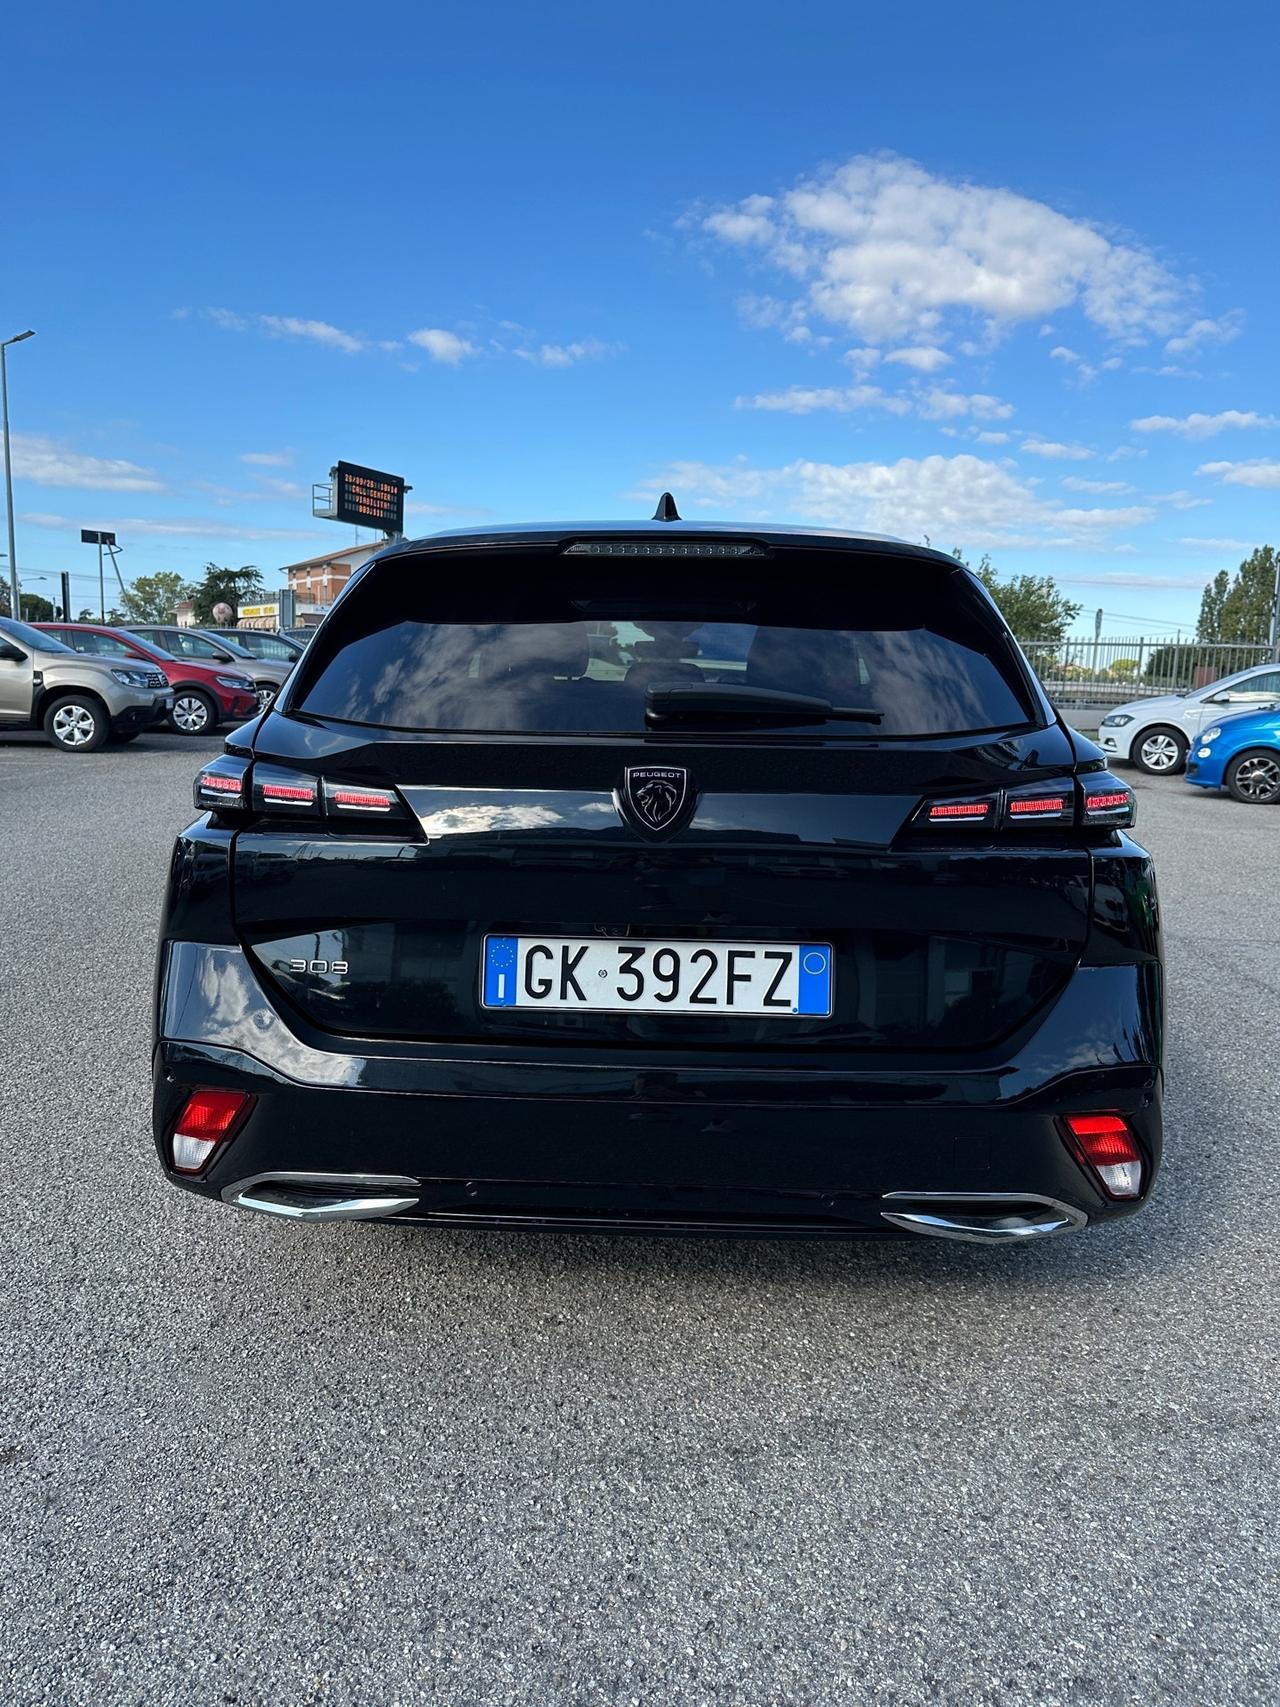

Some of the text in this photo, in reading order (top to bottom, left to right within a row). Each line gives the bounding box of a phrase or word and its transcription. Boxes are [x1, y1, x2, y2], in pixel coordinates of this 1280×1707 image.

[352, 485, 391, 500] CALL CENTER
[289, 959, 349, 975] 308
[524, 944, 794, 1008] GK 392FZ
